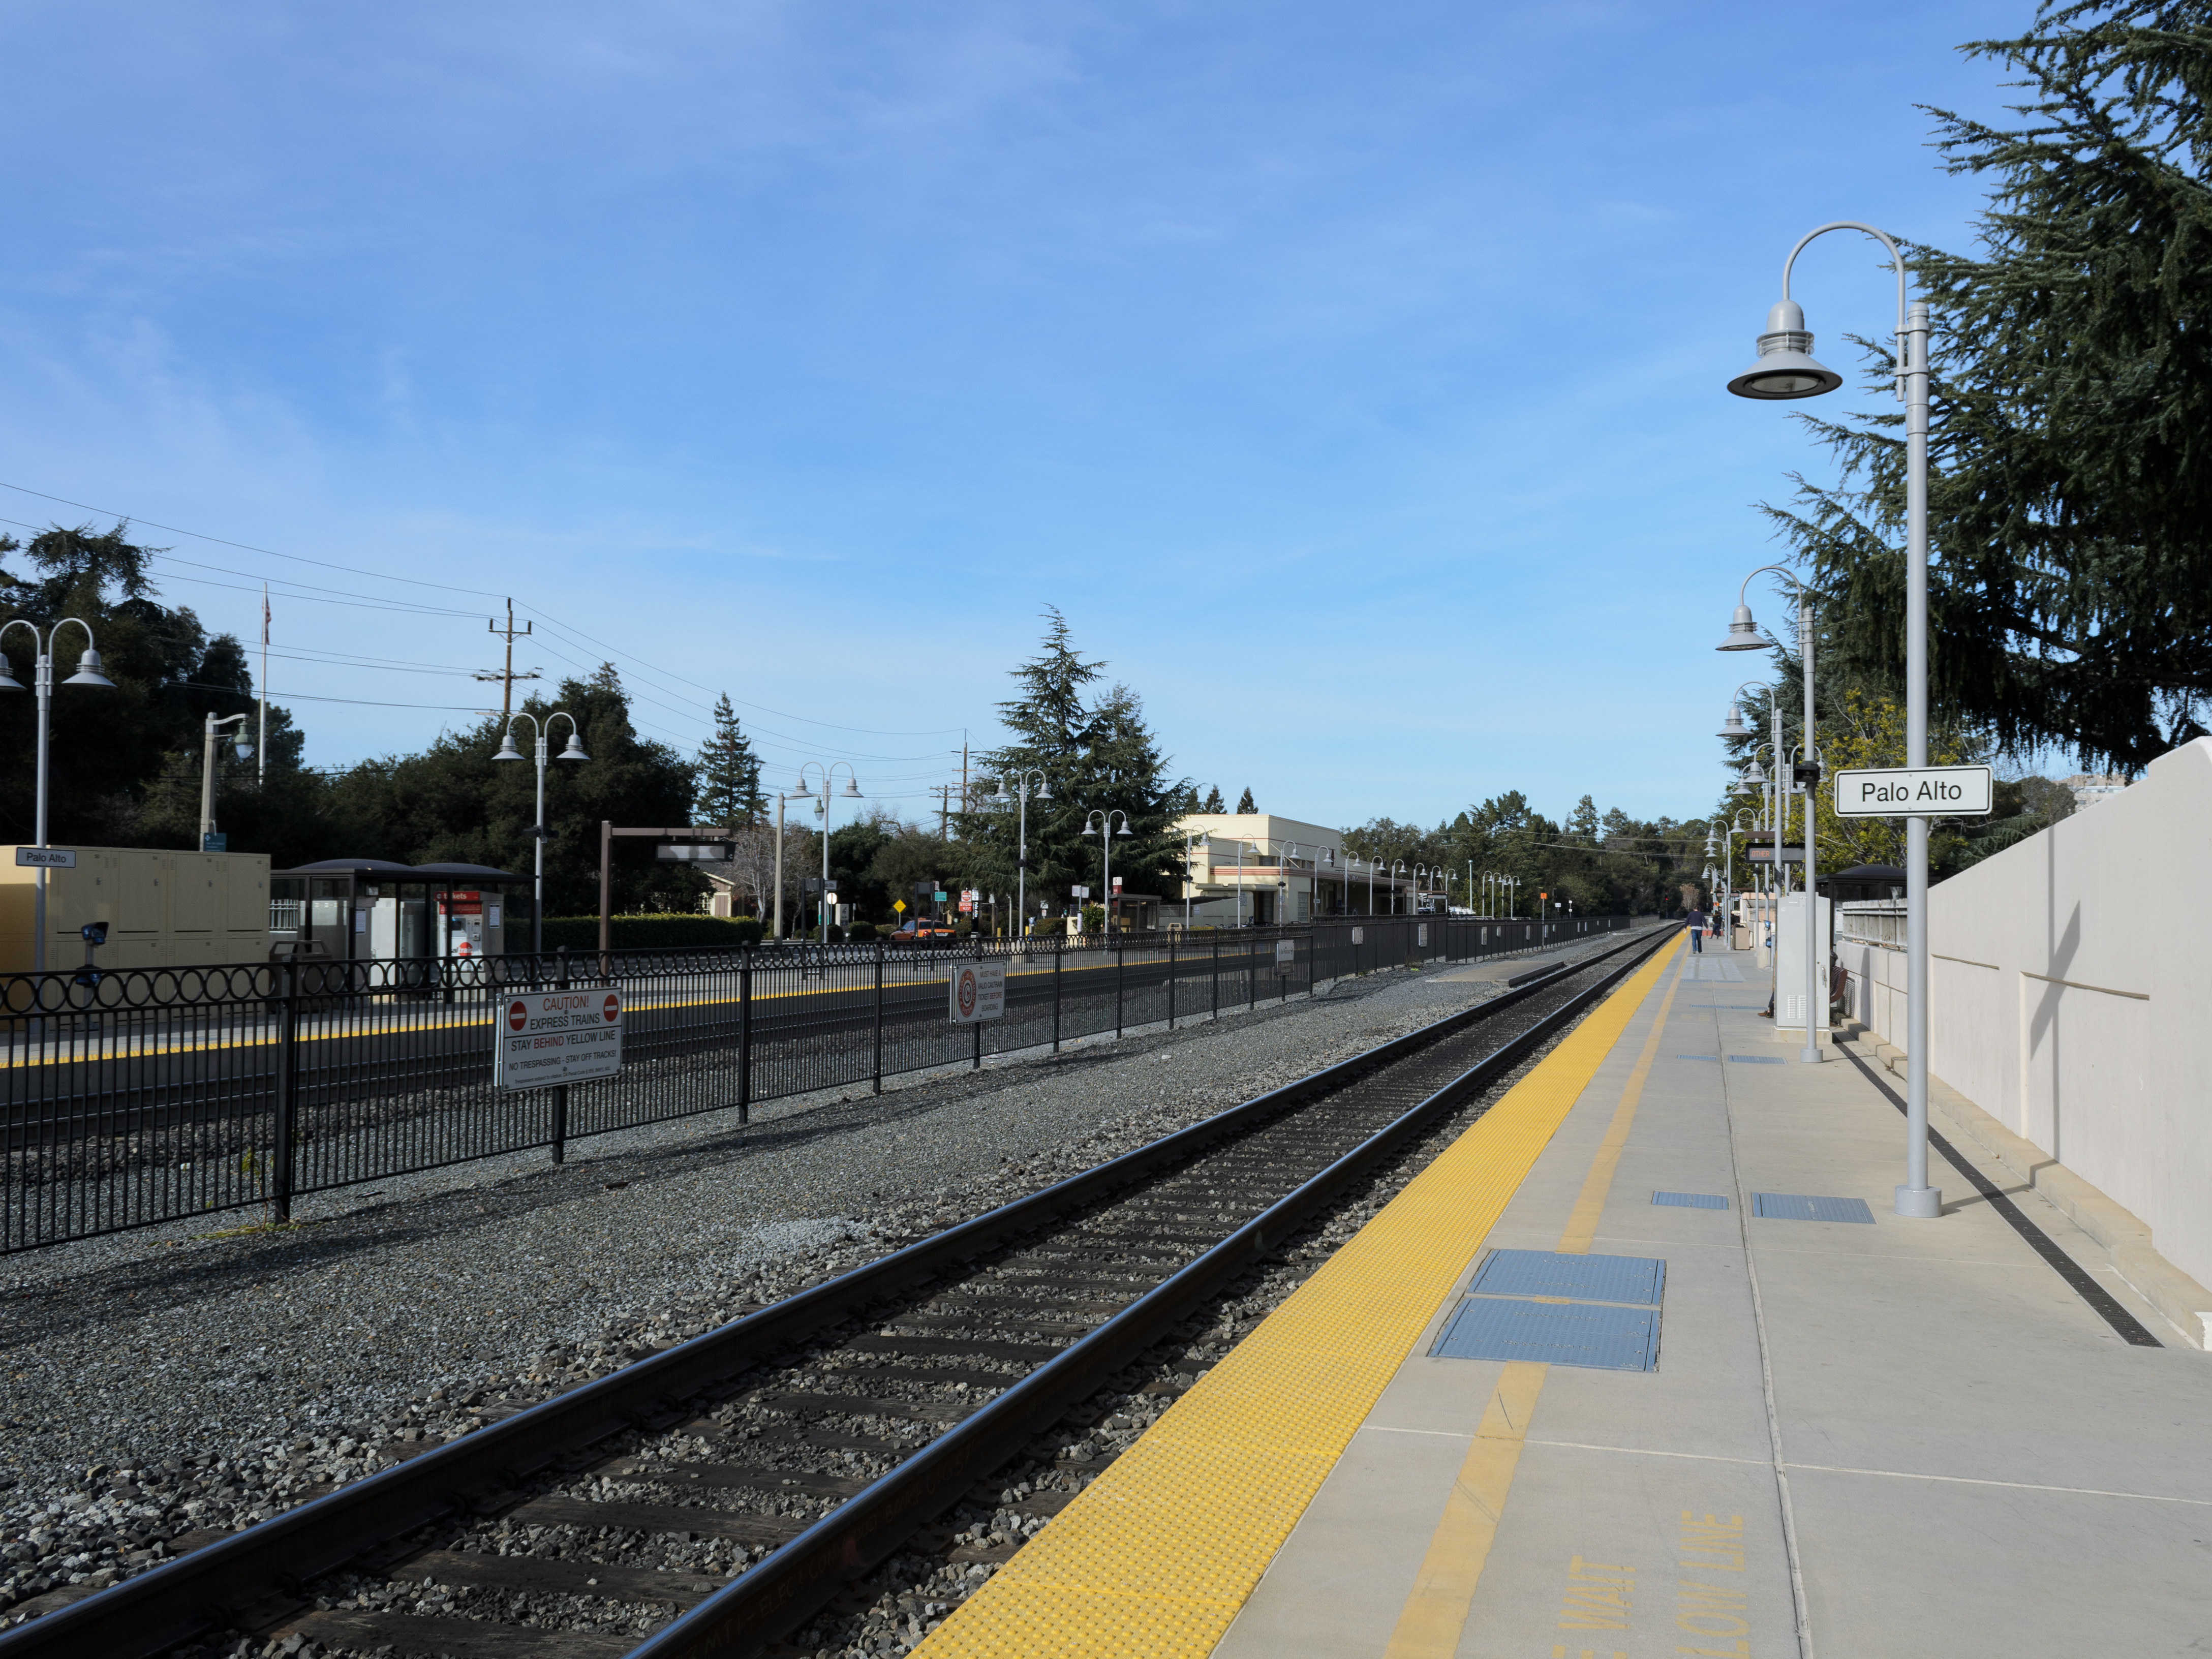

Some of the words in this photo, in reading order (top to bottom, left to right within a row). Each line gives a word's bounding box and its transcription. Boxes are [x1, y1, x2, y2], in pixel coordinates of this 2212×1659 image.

[1862, 782, 1909, 802] Palo
[1916, 780, 1962, 801] Alto
[26, 852, 47, 862] Palo
[49, 854, 67, 863] Alto
[988, 980, 1003, 989] CALTRAIN
[543, 995, 589, 1011] CAUTION!
[990, 992, 1002, 1000] BEFORE
[981, 1003, 998, 1012] BOARDING
[530, 1017, 569, 1030] EXPRESS
[571, 1013, 600, 1026] TRAINS
[511, 1039, 532, 1052] STAY
[534, 1035, 564, 1049] BEHIND
[566, 1031, 598, 1044] YELLOW
[599, 1030, 616, 1041] LINE
[509, 1062, 518, 1071] NO
[520, 1057, 561, 1069] TRESPASSING
[566, 1054, 580, 1063] STAY
[581, 1052, 592, 1062] OFF
[593, 1050, 617, 1060] TRACKS!
[1679, 1510, 1746, 1572] LINE
[1557, 1555, 1636, 1630] WAIT
[1675, 1579, 1750, 1659] LOW
